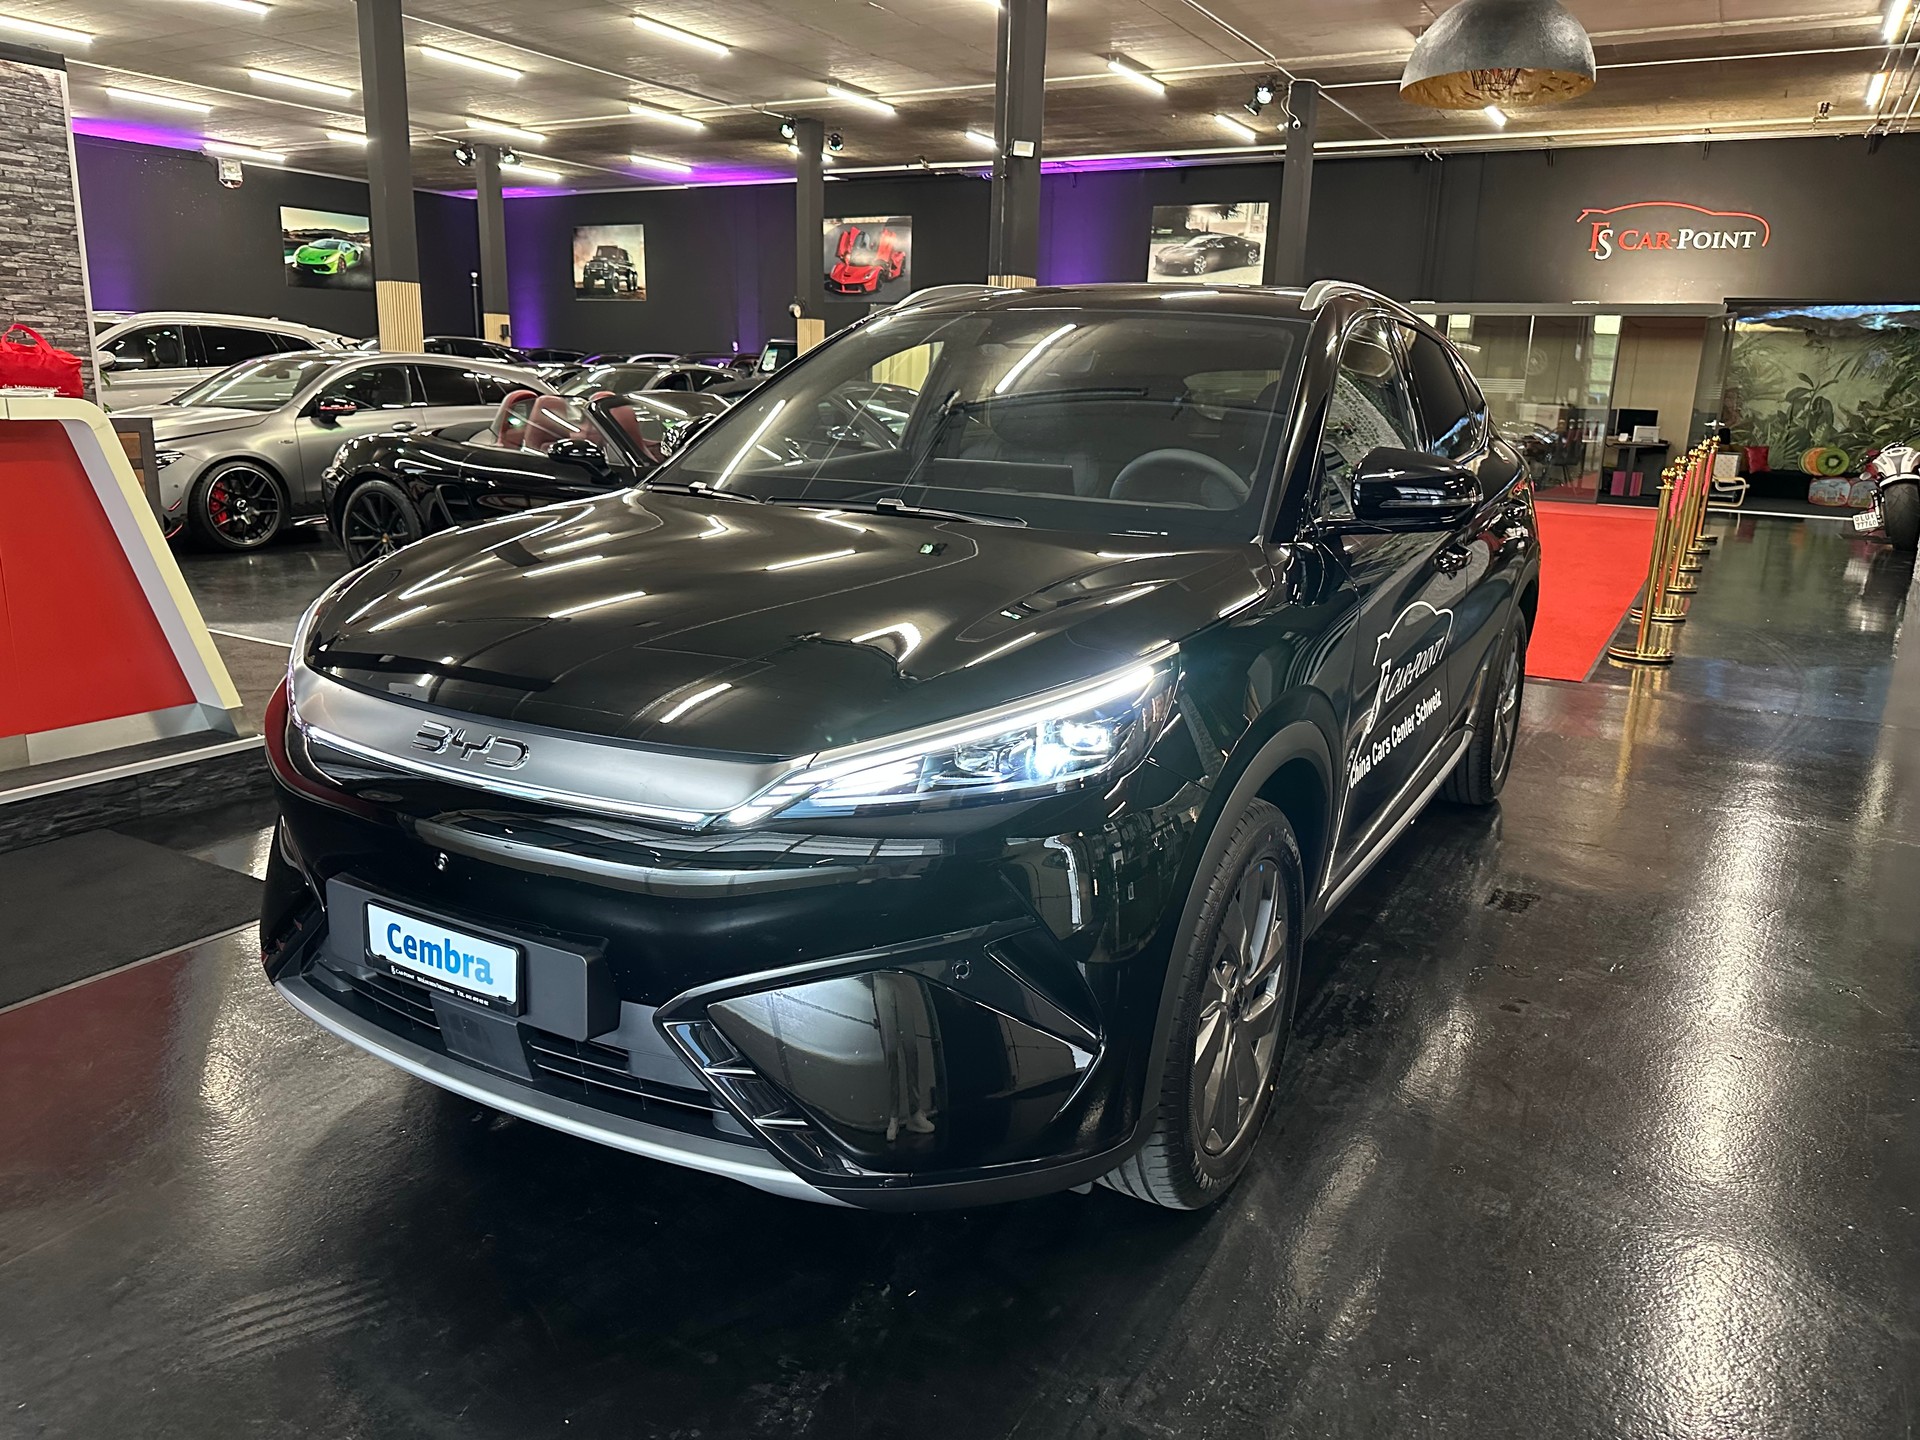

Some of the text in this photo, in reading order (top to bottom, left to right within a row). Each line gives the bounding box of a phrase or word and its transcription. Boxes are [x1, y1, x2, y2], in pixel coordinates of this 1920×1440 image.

[1617, 228, 1757, 250] CAR-POINT
[410, 720, 531, 771] BYD
[1349, 687, 1442, 789] China Cars Center Schweiz
[387, 922, 494, 986] Cembra
